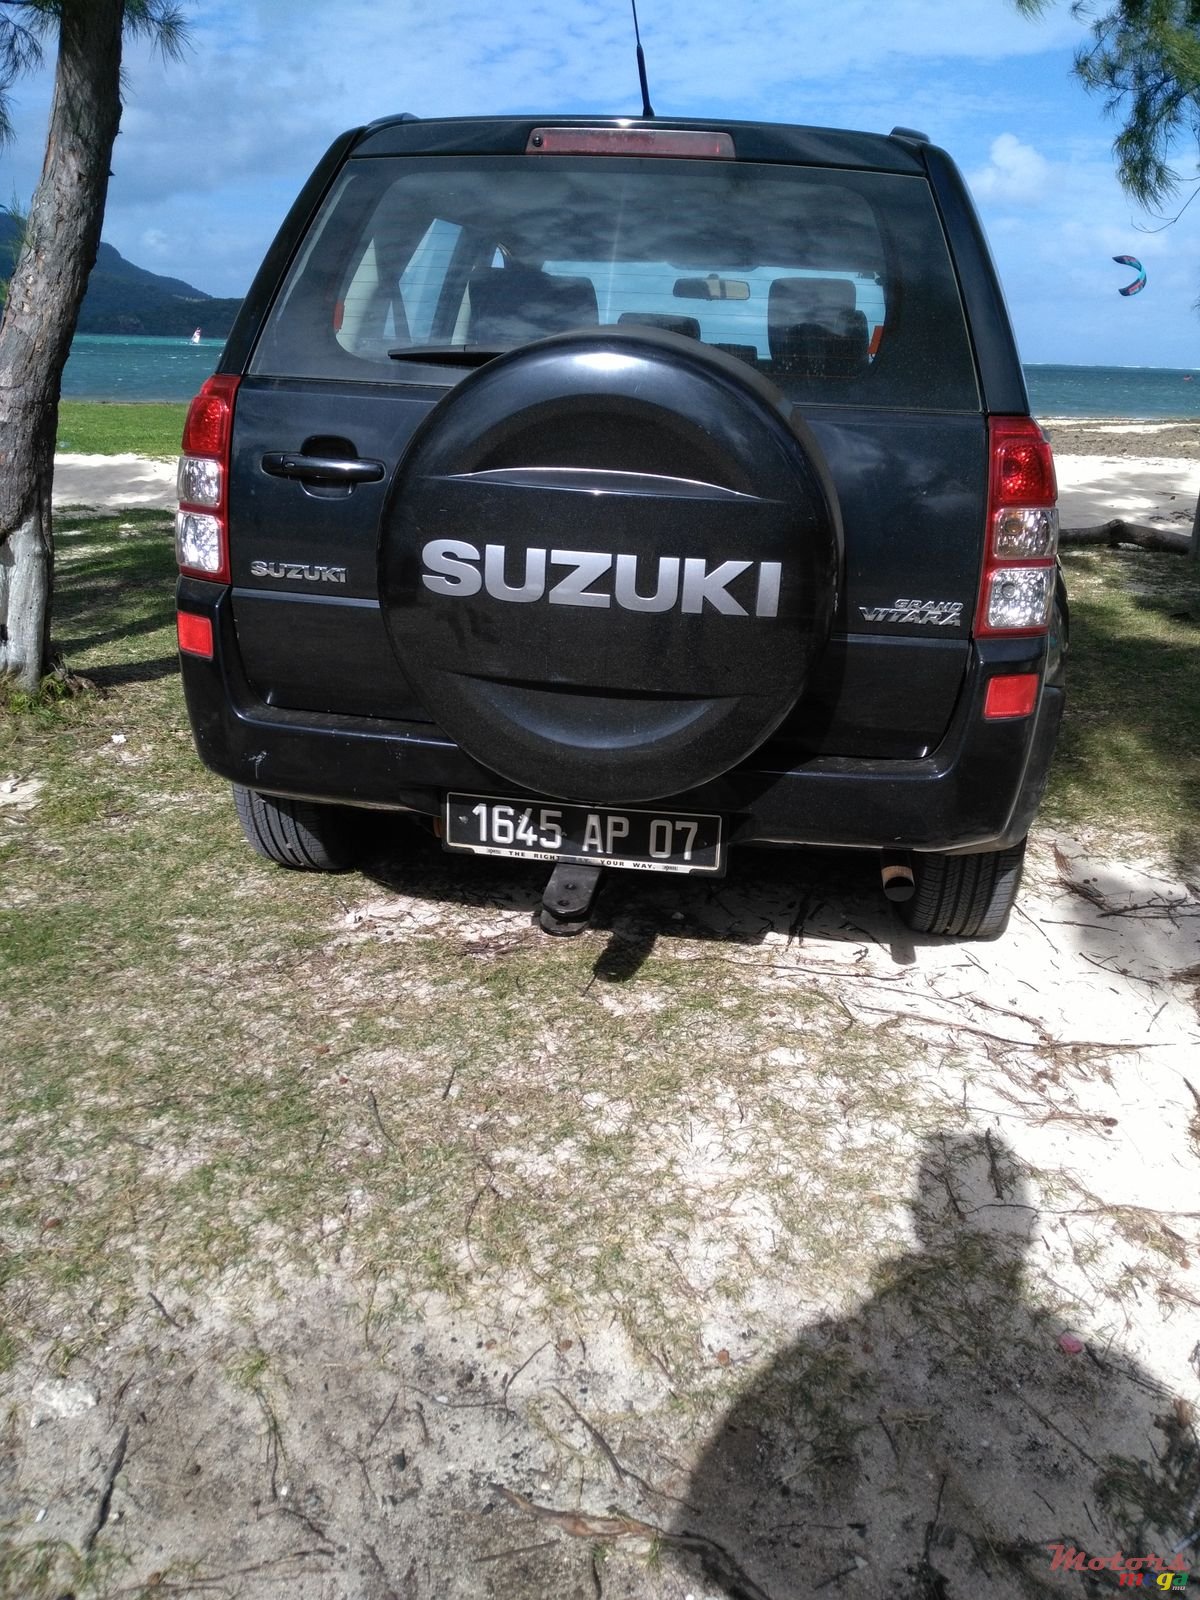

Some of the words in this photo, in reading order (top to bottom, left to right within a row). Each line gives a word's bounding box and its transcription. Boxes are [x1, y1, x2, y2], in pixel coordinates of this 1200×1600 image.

[250, 560, 347, 584] SUZUKI
[421, 538, 783, 618] SUZUKI
[858, 606, 961, 627] VITARA
[894, 598, 964, 613] GRAND
[471, 802, 563, 849] 1645
[581, 813, 631, 854] AP
[649, 819, 699, 860] 07
[508, 850, 526, 858] THE
[533, 853, 561, 861] RIGHT
[600, 859, 625, 867] YOUR
[632, 862, 656, 870] WAY.
